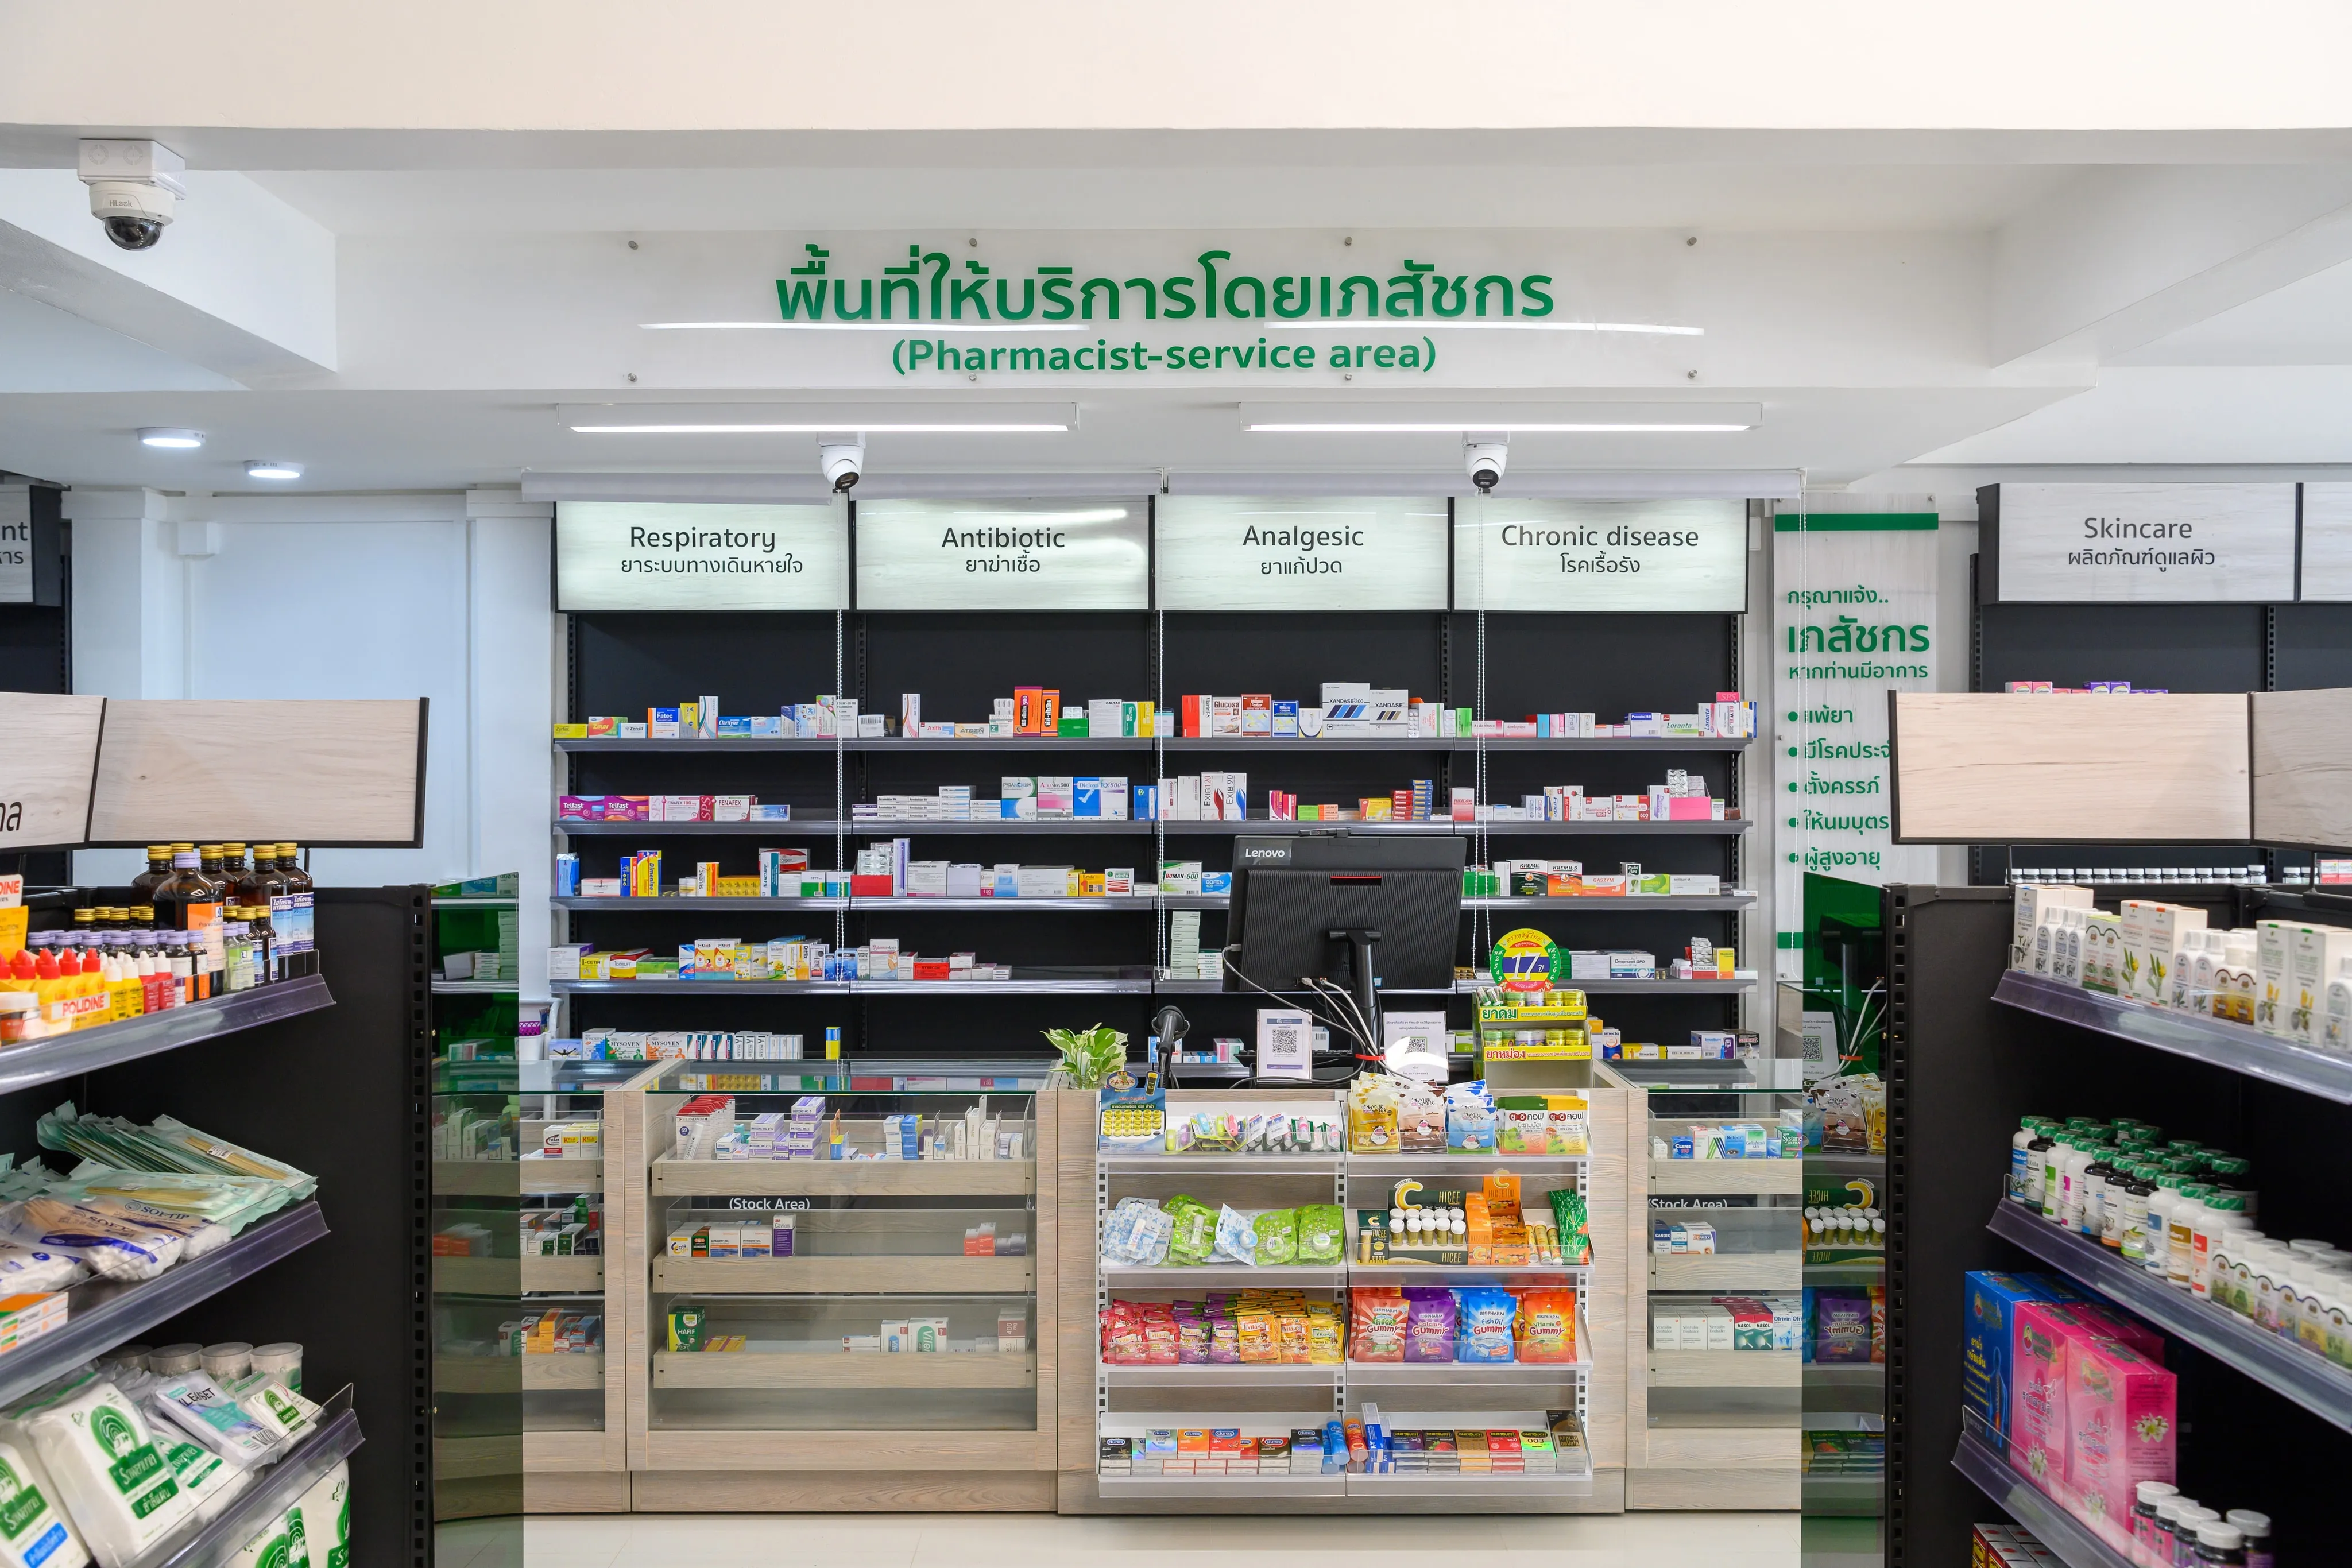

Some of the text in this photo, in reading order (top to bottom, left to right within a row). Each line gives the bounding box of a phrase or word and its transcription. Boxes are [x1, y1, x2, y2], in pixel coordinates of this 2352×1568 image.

[776, 243, 1554, 322] พื้นที่ให้บริการโดยเภสัชกร
[892, 336, 1437, 375] (Pharmacist-service area)
[941, 526, 1066, 549] Antibiotic
[1242, 525, 1364, 553] Analgesic
[1500, 524, 1699, 547] Chronic disease
[2083, 517, 2194, 539] Skincare
[630, 526, 776, 553] Respiratory
[621, 552, 803, 574] ยาระบบทางเดินหายใจ
[965, 549, 1041, 574] ยาฆ่าเชื้อ
[1260, 552, 1343, 575] ยาแก้ปวด
[1560, 551, 1641, 574] โรคเรื้อรัง
[2068, 548, 2215, 573] ผลิตภัณฑ์ดูแลผิว
[1788, 615, 1931, 653] เภสัชกร
[1788, 663, 1928, 680] หากท่านมีอาการ
[1214, 700, 1240, 708] Glucosa
[1804, 704, 1854, 724] แพ้ยา
[1227, 775, 1234, 785] 90
[1804, 771, 1880, 795] ตั้งครรภ์
[651, 796, 662, 820] SPS
[701, 796, 712, 820] SPS
[1804, 809, 1890, 835] ให้นมบุตร
[1245, 848, 1285, 858] Lenovo
[1804, 849, 1881, 872] ผู้สูงอายุ
[1507, 950, 1542, 982] 17
[61, 995, 106, 1016] POLIDINE
[1482, 1008, 1518, 1020] ยาดม
[1486, 1047, 1526, 1059] ยาหม่อง
[1782, 1135, 1802, 1144] Systane
[1395, 1178, 1412, 1189] VITAMIN
[729, 1198, 810, 1209] (Stock Area)
[1438, 1190, 1461, 1203] HICEE
[1693, 1198, 1727, 1208] Area)
[141, 1205, 190, 1221] SOFTIP
[1372, 1229, 1387, 1237] HICEE
[1442, 1252, 1461, 1263] HICEE
[1481, 1317, 1494, 1325] Fish
